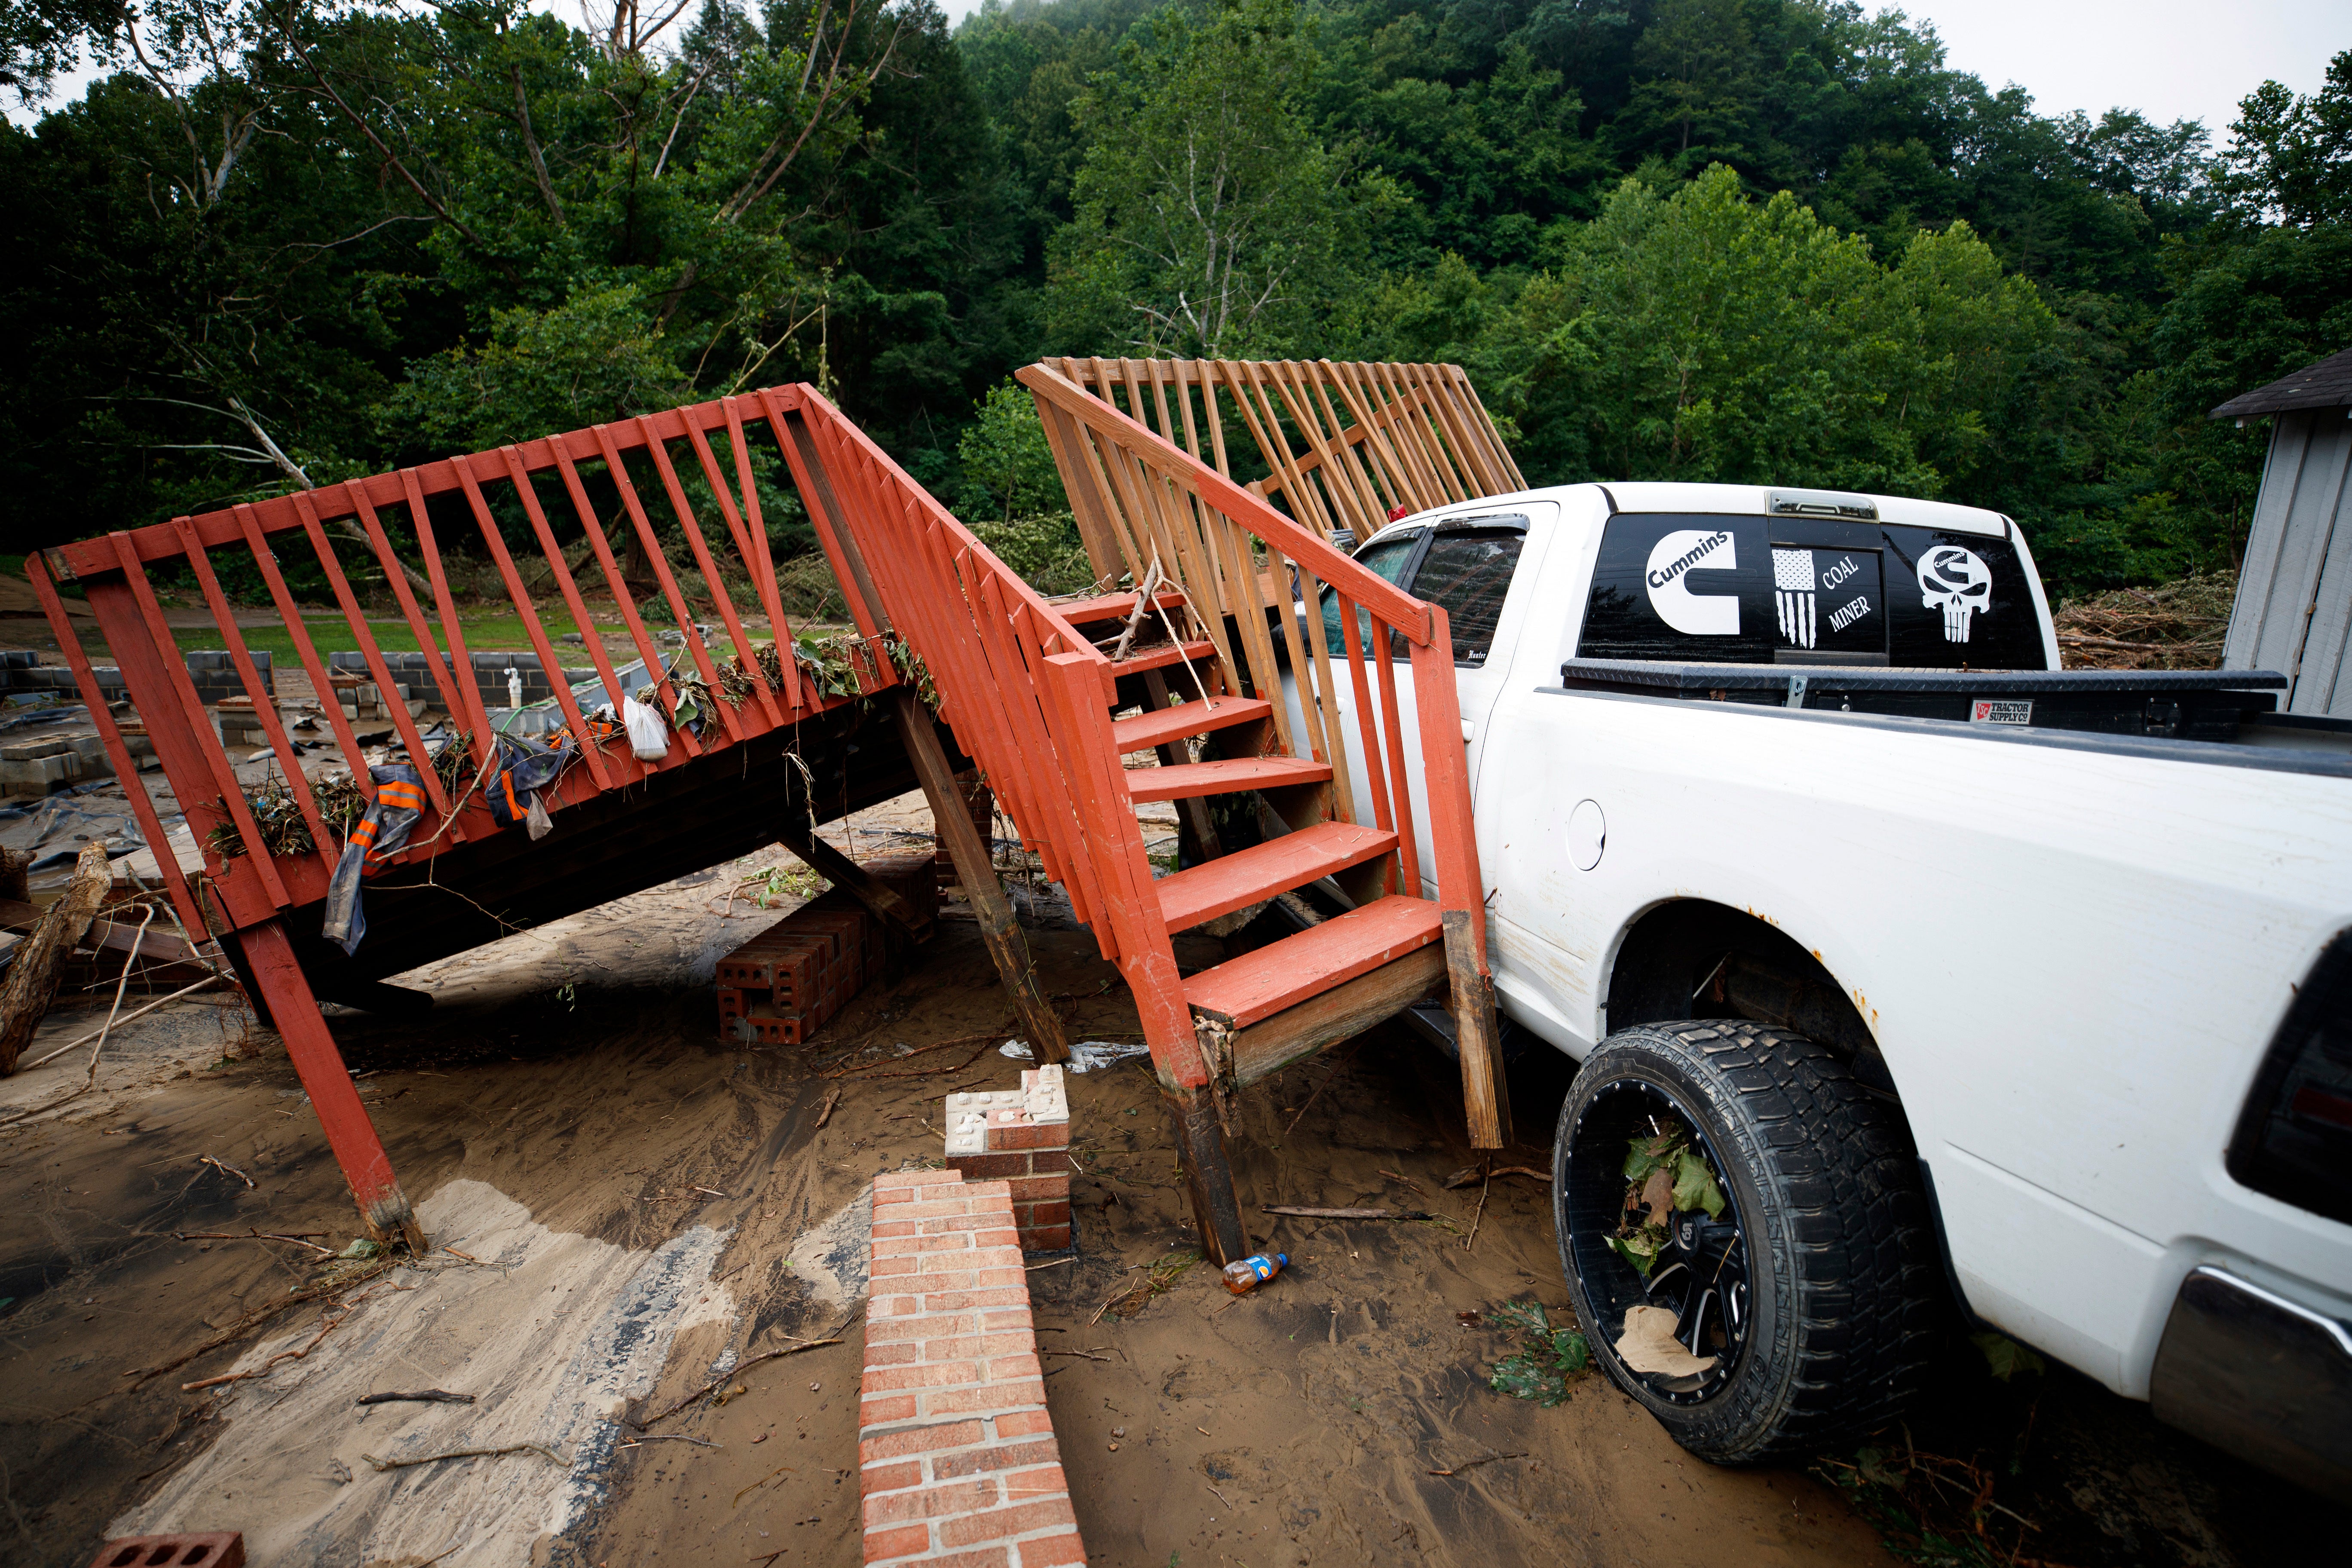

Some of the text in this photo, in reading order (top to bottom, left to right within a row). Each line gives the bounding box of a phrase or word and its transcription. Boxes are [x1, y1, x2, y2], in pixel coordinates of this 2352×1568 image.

[1648, 531, 1728, 588] Cummins
[1934, 552, 1965, 568] Cummins
[1823, 556, 1859, 590] COAL
[1828, 596, 1871, 632] MINER
[1467, 650, 1486, 661] Hunter
[1977, 704, 1988, 717] TSC
[1991, 703, 2029, 712] TRACTOR
[1989, 712, 2019, 721] SUPPLY
[1685, 1354, 1767, 1438] GLADIATOR
